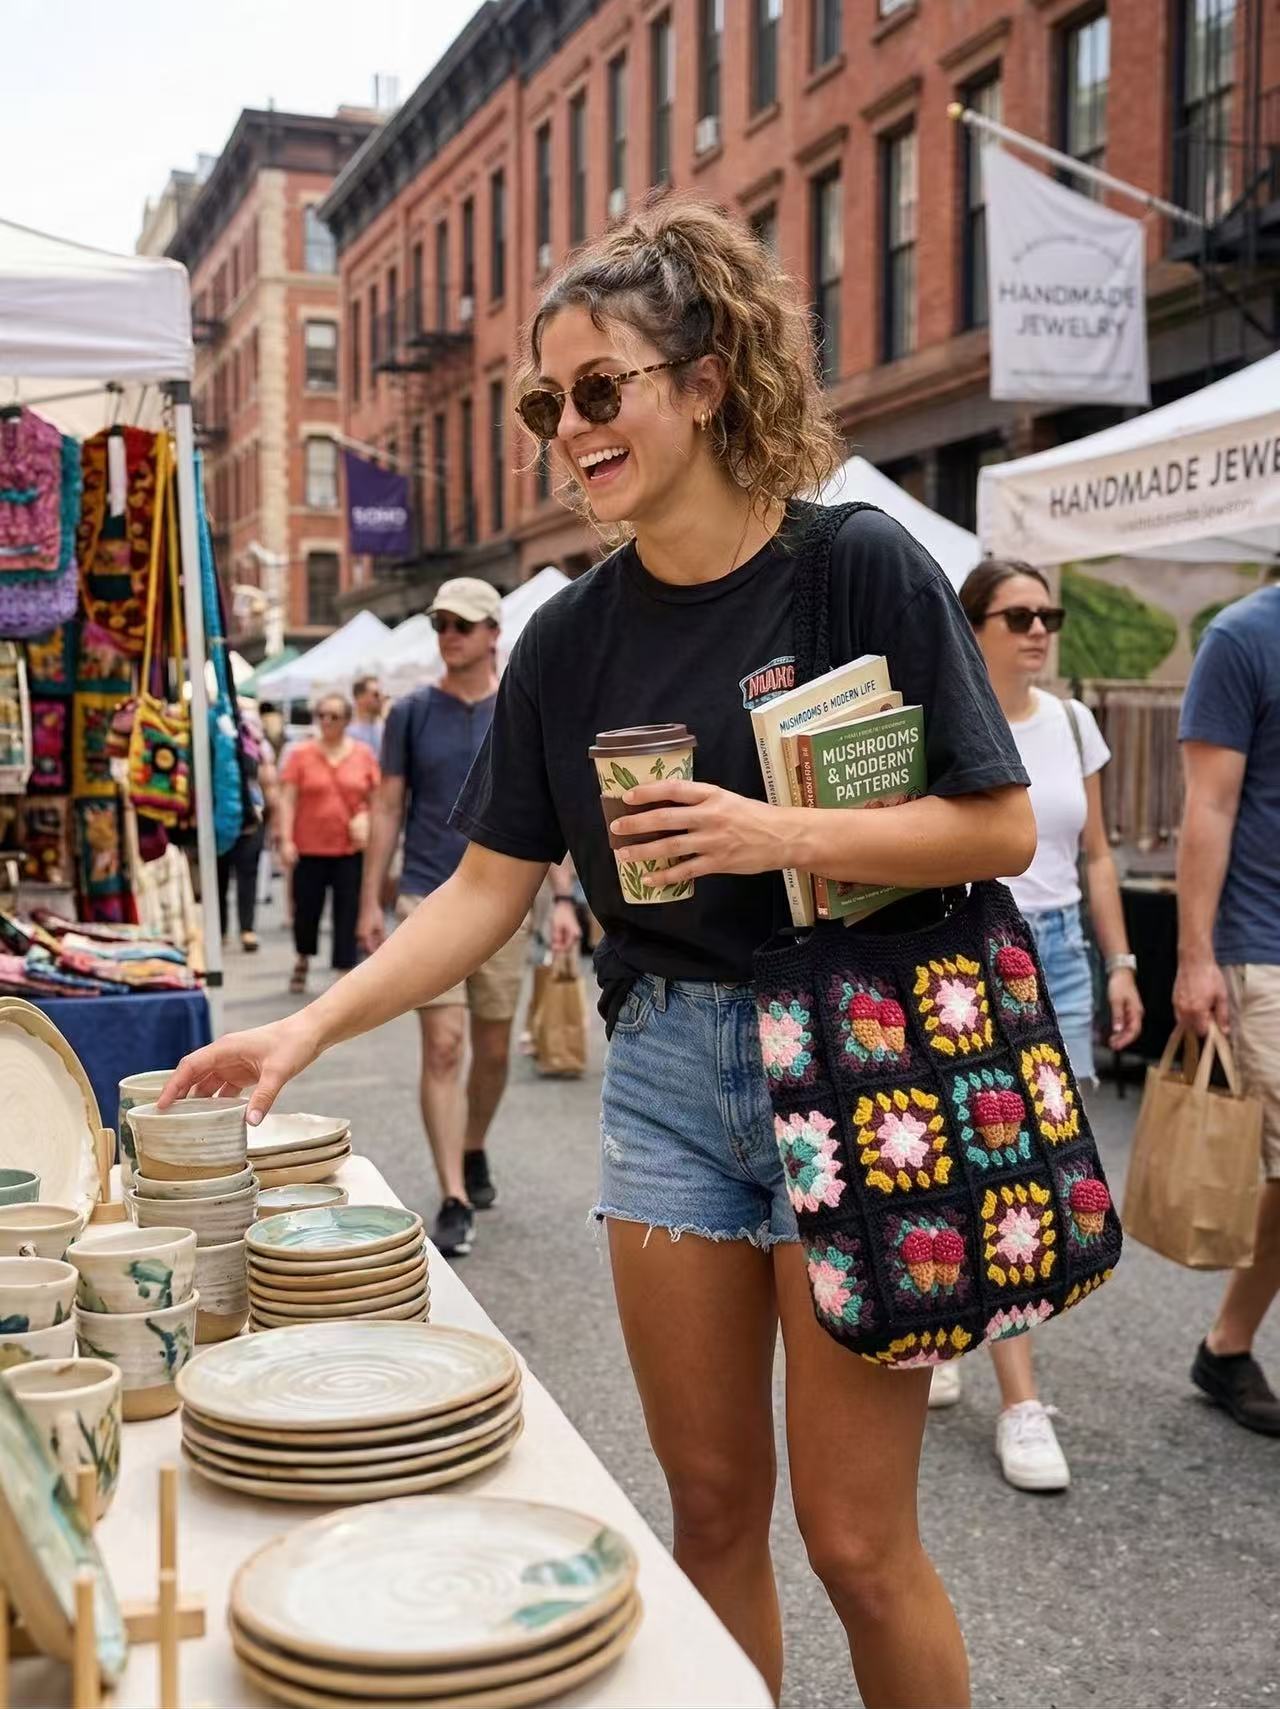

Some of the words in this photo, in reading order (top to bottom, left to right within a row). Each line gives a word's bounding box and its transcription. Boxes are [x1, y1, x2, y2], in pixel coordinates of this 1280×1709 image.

[998, 284, 1136, 309] HANDMADE
[1017, 313, 1126, 338] JEWELRY
[1050, 456, 1199, 519] HANDMADE
[779, 702, 822, 733] MUSHROOMS
[823, 701, 829, 713] &
[830, 687, 859, 707] MODERN
[860, 679, 877, 697] LIFE
[822, 727, 919, 766] MUSHROOMS
[827, 767, 840, 784] &
[845, 747, 915, 780] MODERNY
[836, 768, 910, 801] PATTERNS
